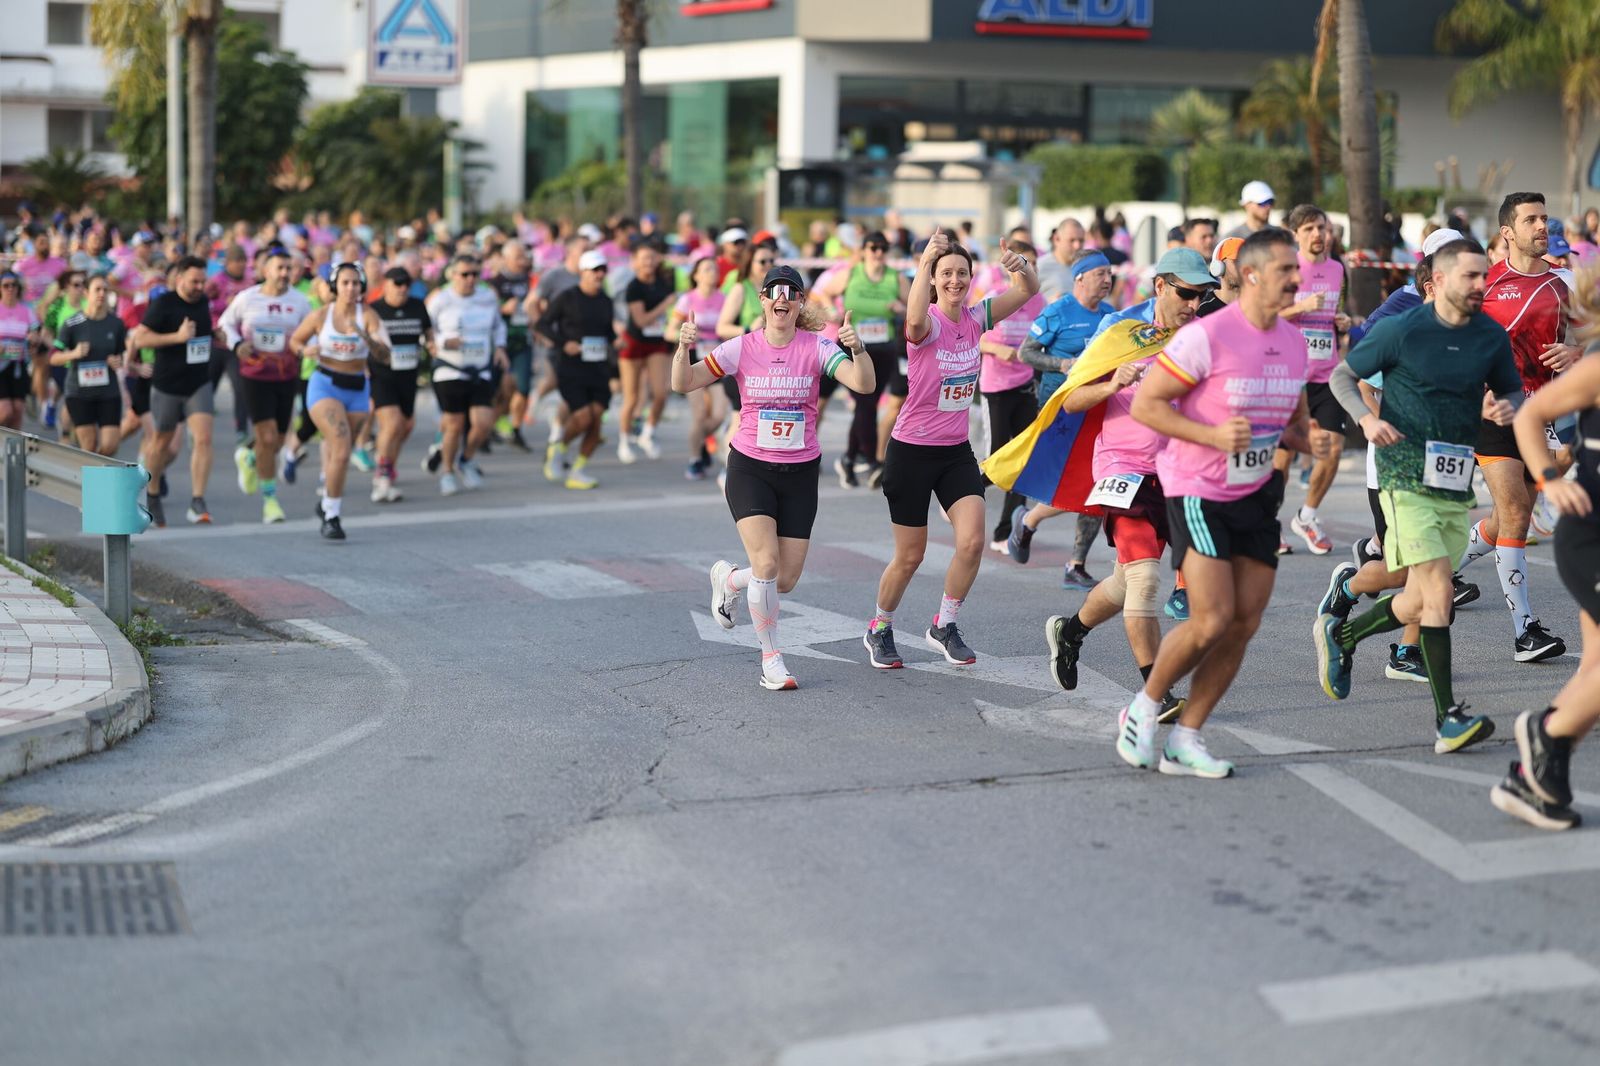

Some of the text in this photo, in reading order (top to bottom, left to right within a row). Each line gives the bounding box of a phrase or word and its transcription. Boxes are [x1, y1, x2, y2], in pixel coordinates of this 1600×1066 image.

[1498, 292, 1521, 300] MVM
[767, 366, 791, 376] XXXVI
[745, 375, 769, 388] MEDIA
[746, 389, 794, 398] INTERNACIONAL
[943, 382, 974, 400] 1545
[771, 421, 795, 437] 57
[1436, 456, 1465, 476] 851
